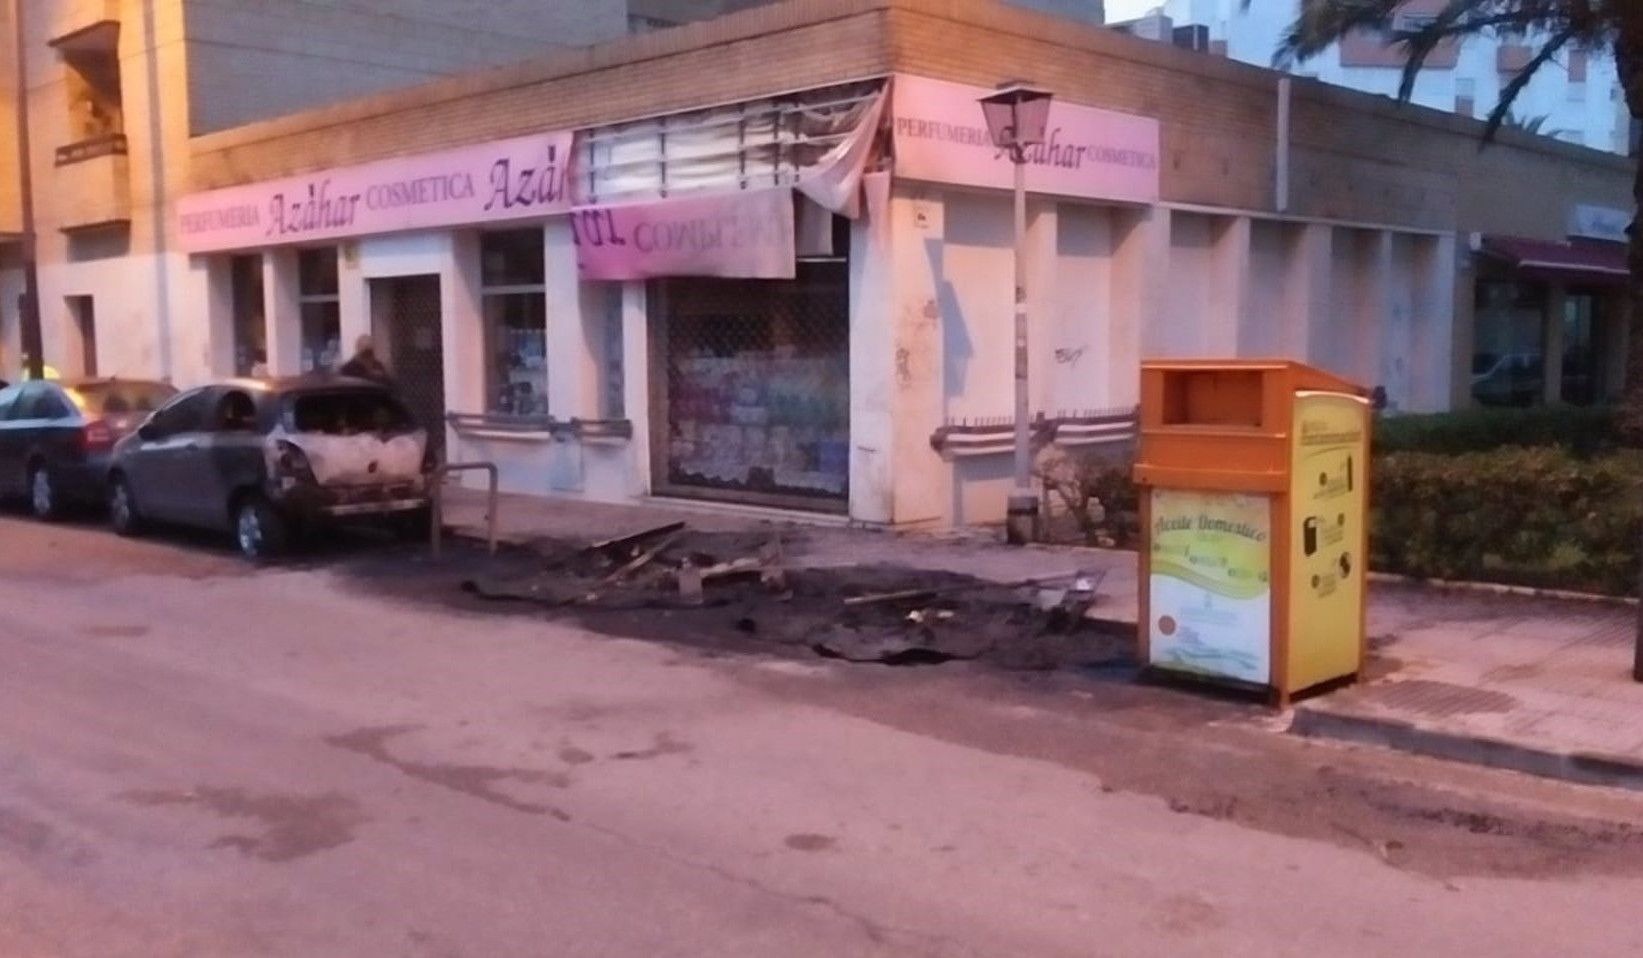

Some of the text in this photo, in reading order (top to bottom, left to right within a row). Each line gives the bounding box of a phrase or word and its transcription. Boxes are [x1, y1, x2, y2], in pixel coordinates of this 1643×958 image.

[897, 117, 992, 148] PERFUMERIA
[1087, 143, 1157, 170] COSMETICA
[180, 204, 260, 235] PERFUMERIA
[366, 172, 475, 211] COSMETICA
